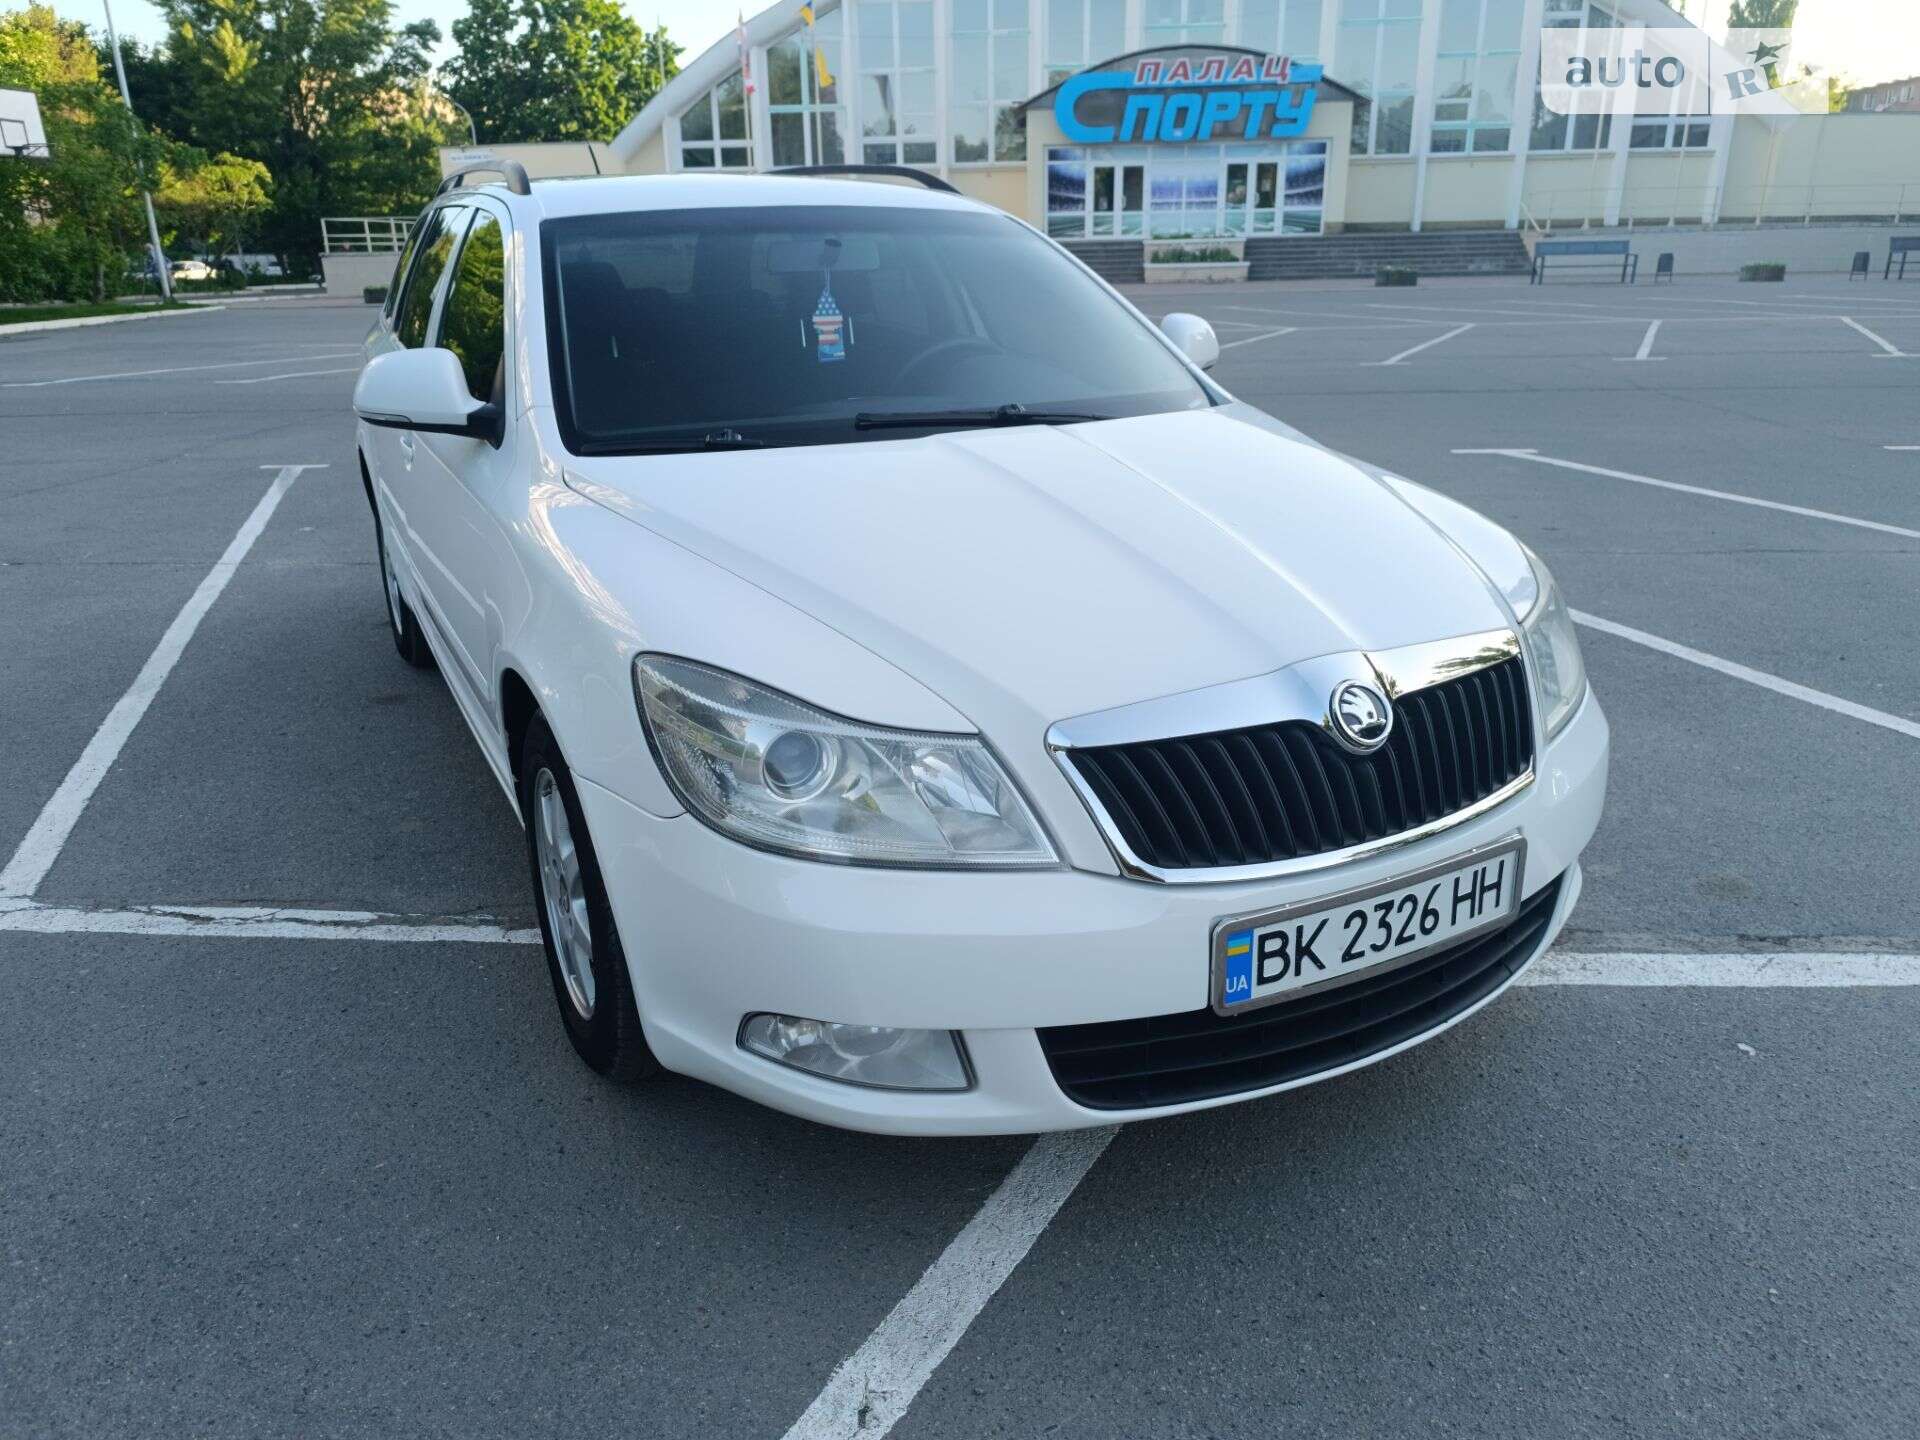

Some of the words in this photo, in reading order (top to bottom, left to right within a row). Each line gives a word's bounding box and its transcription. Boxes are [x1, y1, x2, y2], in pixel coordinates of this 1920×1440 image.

[1134, 56, 1293, 85] ПАЛАЦ
[1256, 918, 1329, 985] BK
[1341, 883, 1441, 963] 2326
[1450, 859, 1504, 926] HH
[1225, 974, 1248, 994] UA
